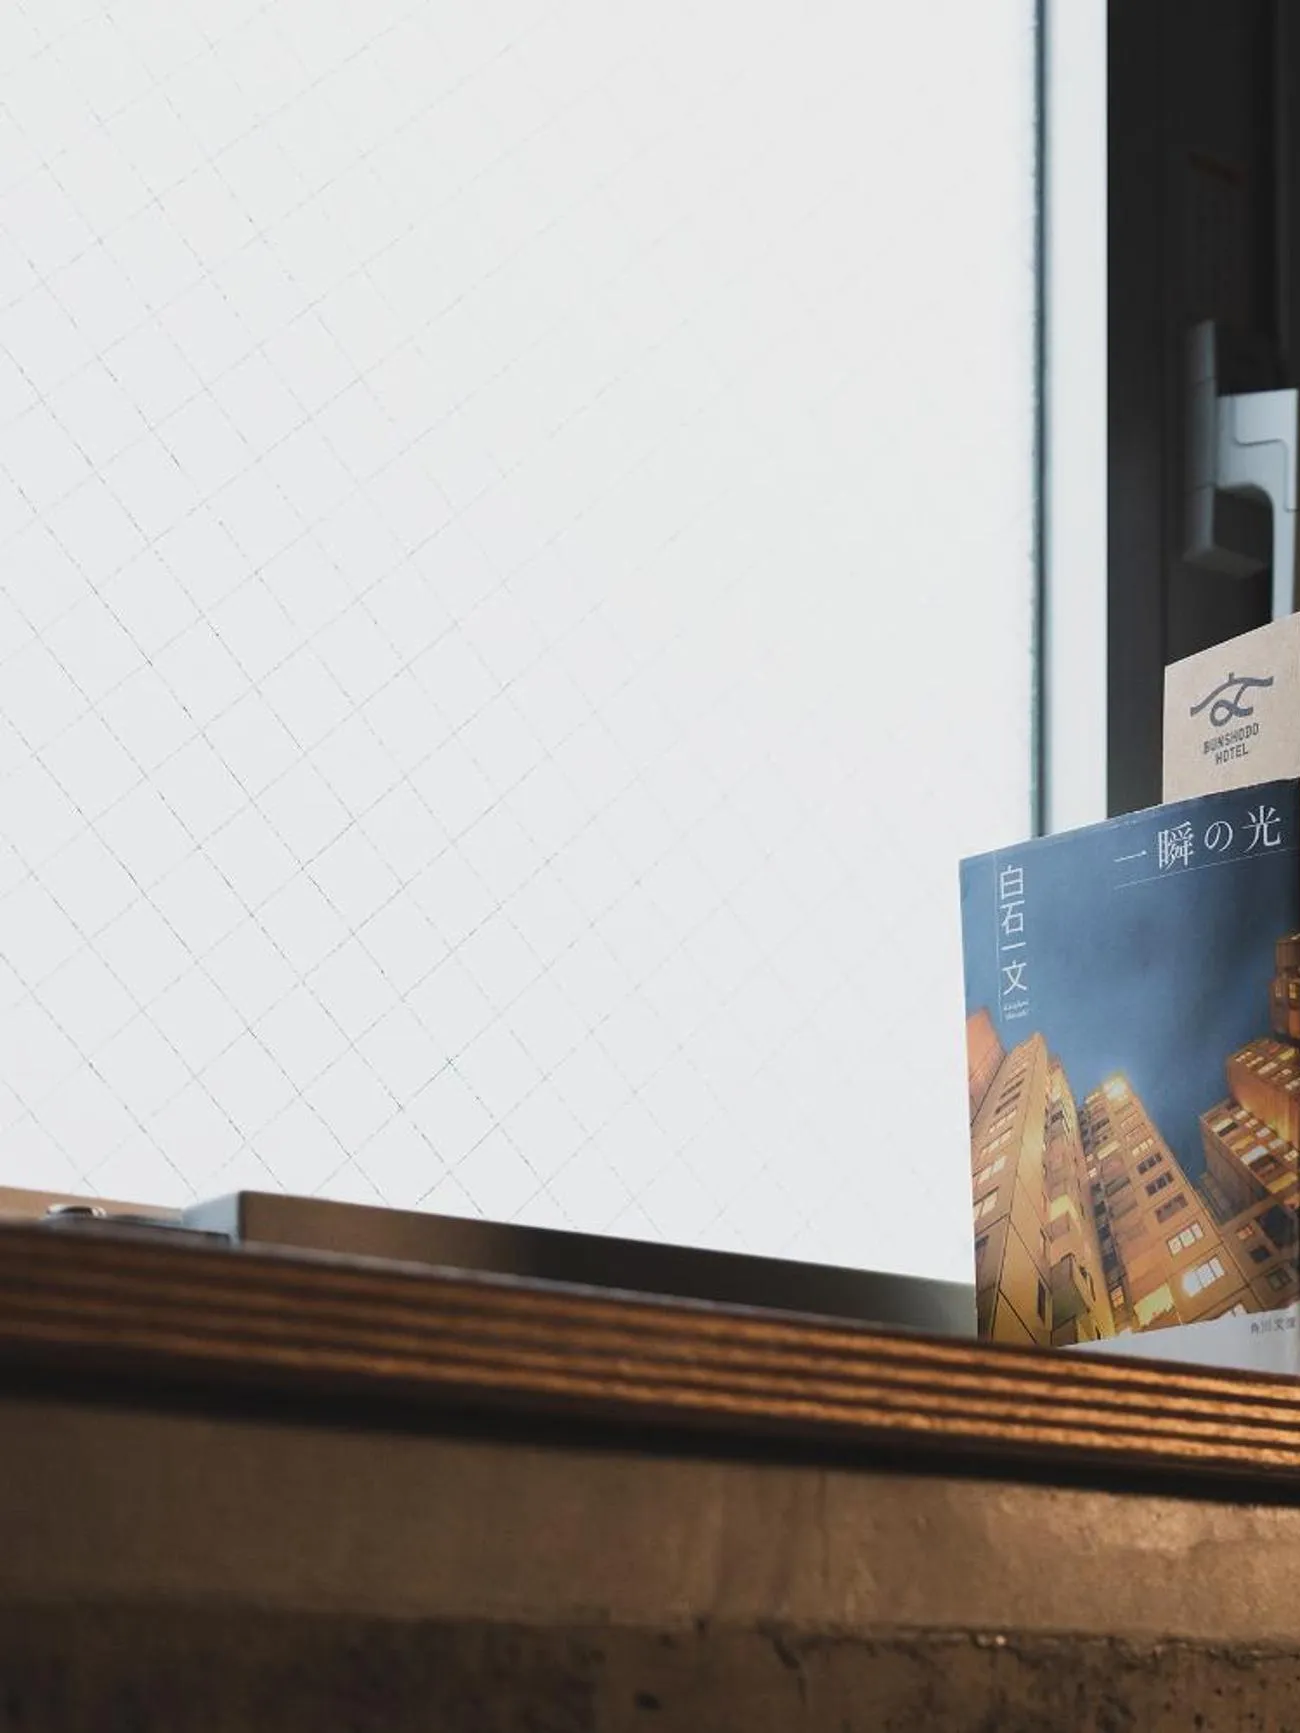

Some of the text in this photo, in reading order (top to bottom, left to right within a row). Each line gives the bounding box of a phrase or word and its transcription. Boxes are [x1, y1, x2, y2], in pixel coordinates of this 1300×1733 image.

[1203, 722, 1260, 755] BUNSHODO
[1215, 742, 1249, 765] HOTEL
[1113, 804, 1281, 871] 一瞬の光
[999, 863, 1028, 995] 白石一文
